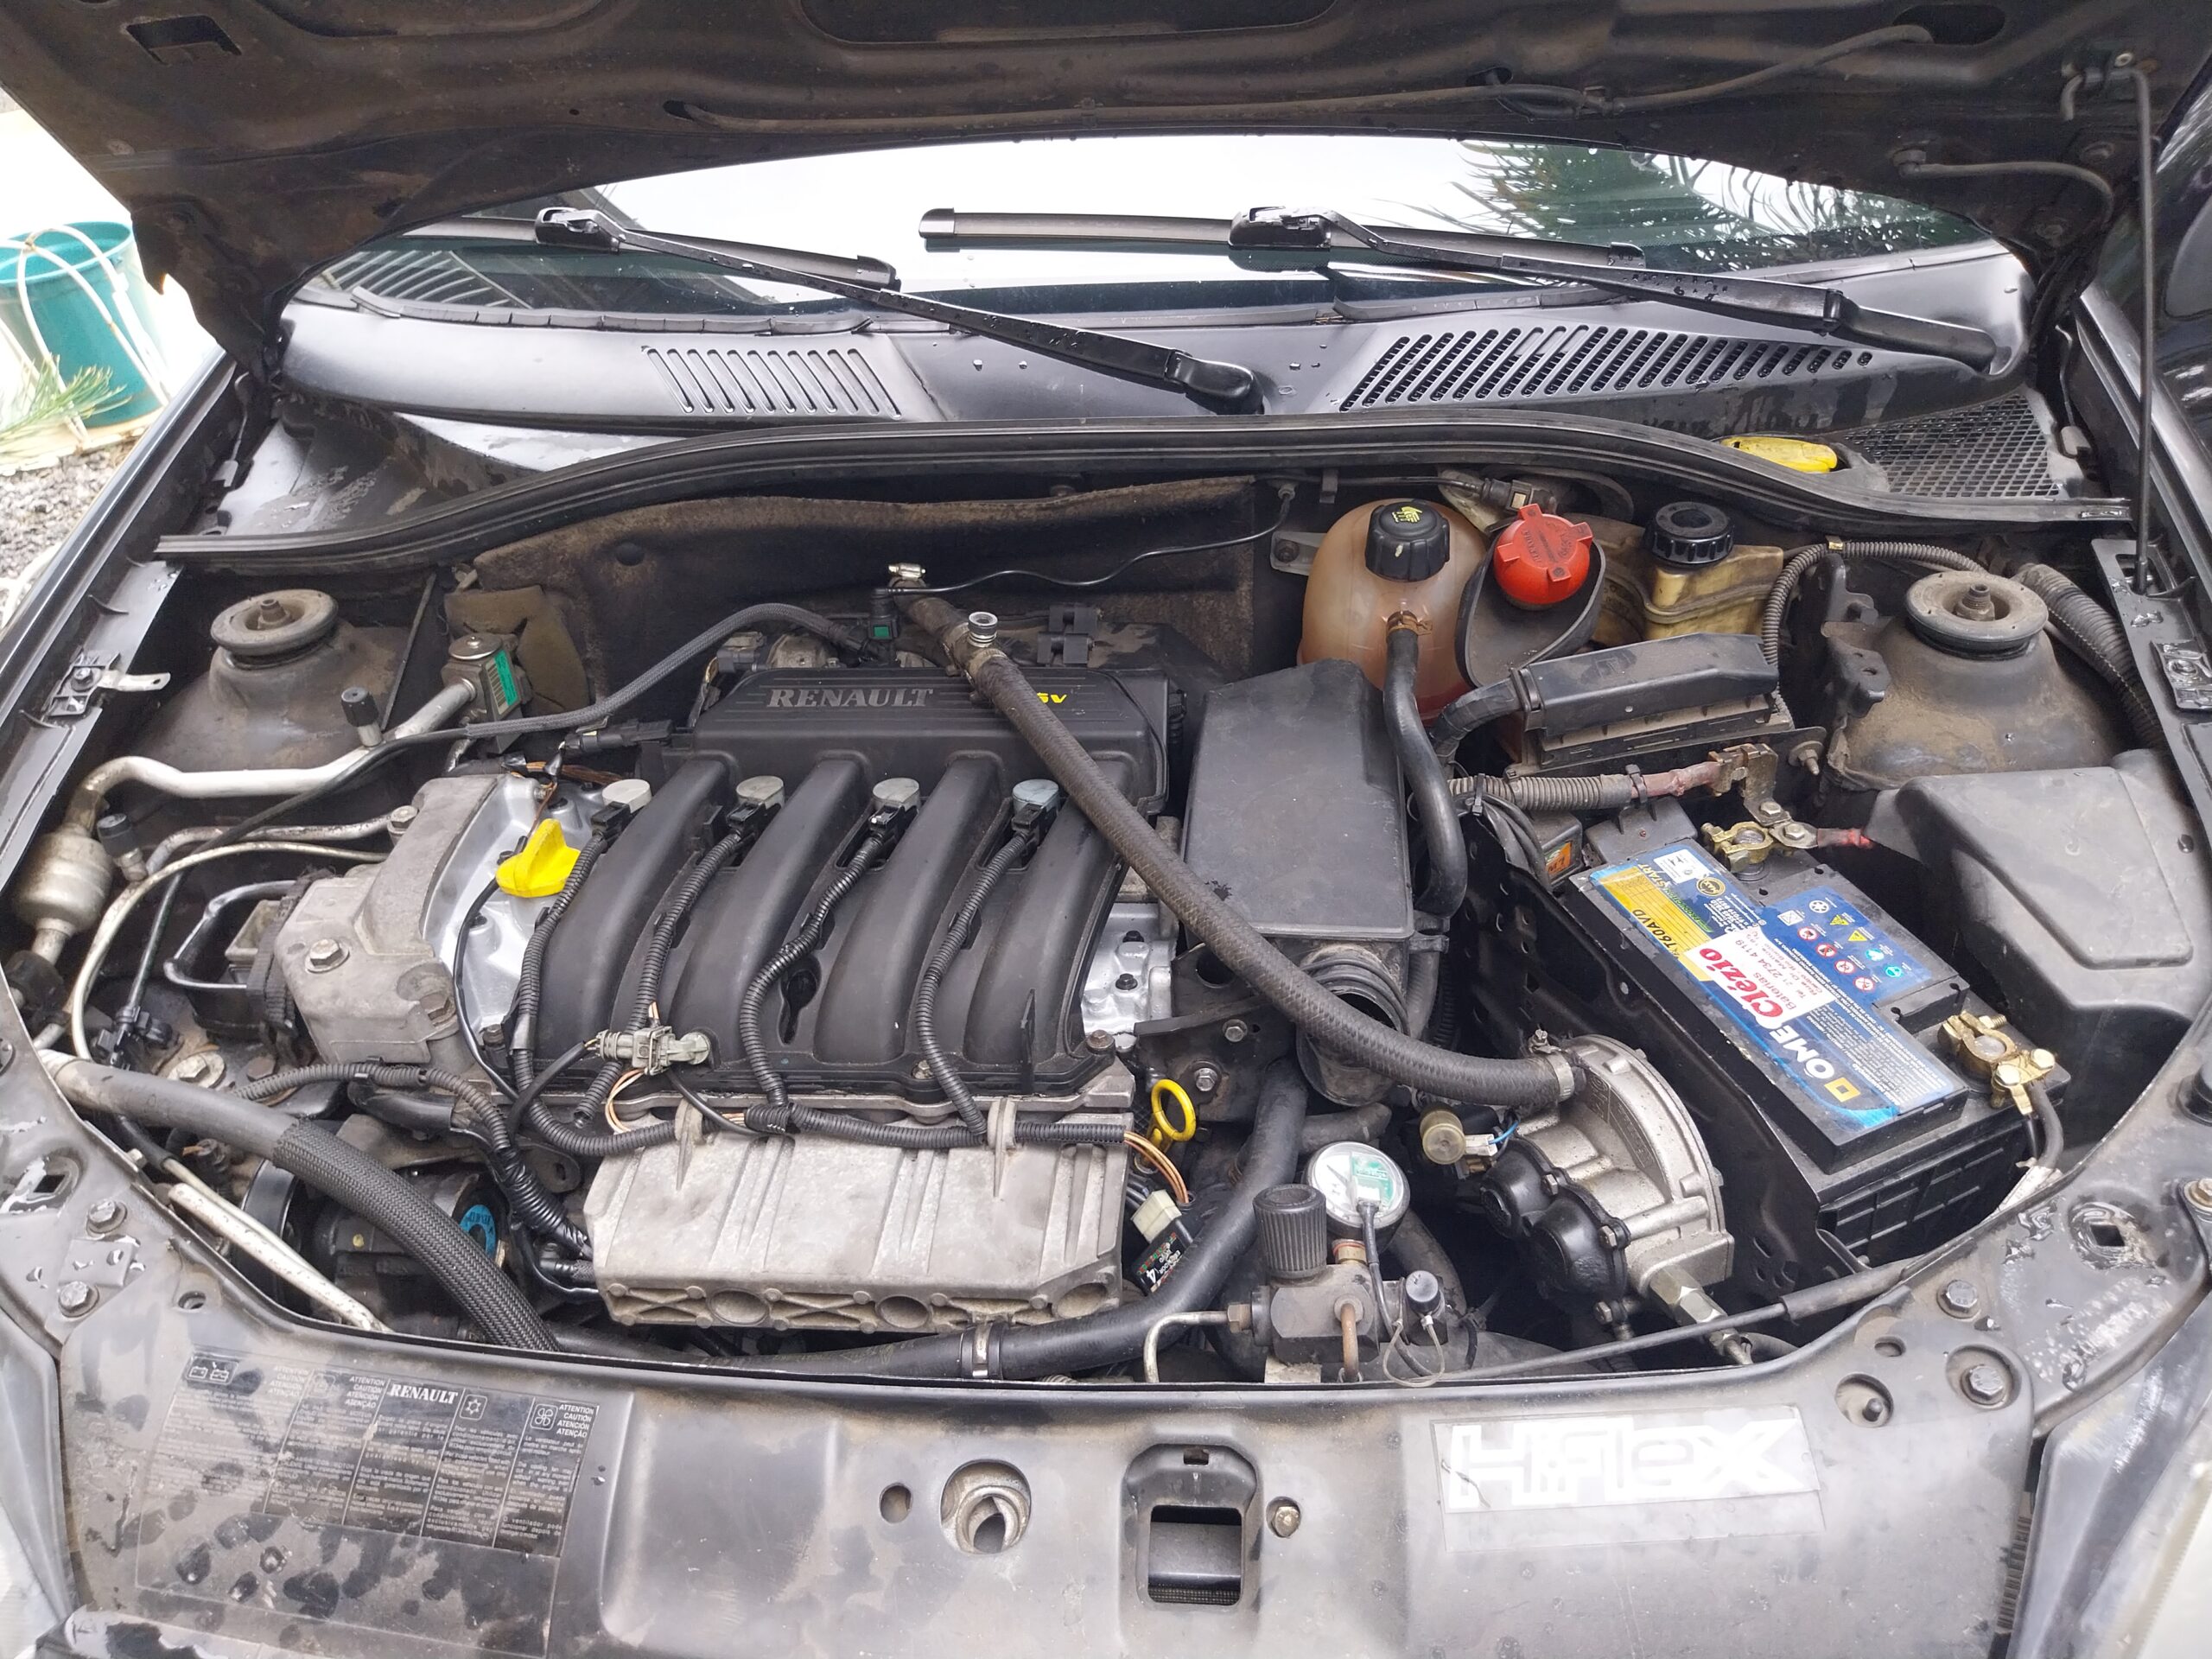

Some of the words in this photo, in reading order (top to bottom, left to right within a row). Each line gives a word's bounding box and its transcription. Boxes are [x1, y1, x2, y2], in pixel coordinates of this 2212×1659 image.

[766, 688, 934, 708] RENAULT
[1634, 861, 1670, 887] START
[1632, 909, 1675, 950] T60AVD
[1732, 938, 1760, 957] 4119
[1755, 957, 1783, 978] 2734
[1700, 947, 1783, 1019] Clézio
[1749, 971, 1798, 1010] Baterias
[276, 1372, 306, 1382] CAUTION
[348, 1375, 385, 1387] ATTENTION
[353, 1383, 383, 1394] CAUTION
[387, 1382, 459, 1405] RENAULT
[558, 1403, 594, 1414] ATTENTION
[563, 1411, 592, 1422] CAUTION
[556, 1418, 590, 1430] ATENCIÓN
[556, 1427, 588, 1440] ATENÇÃO
